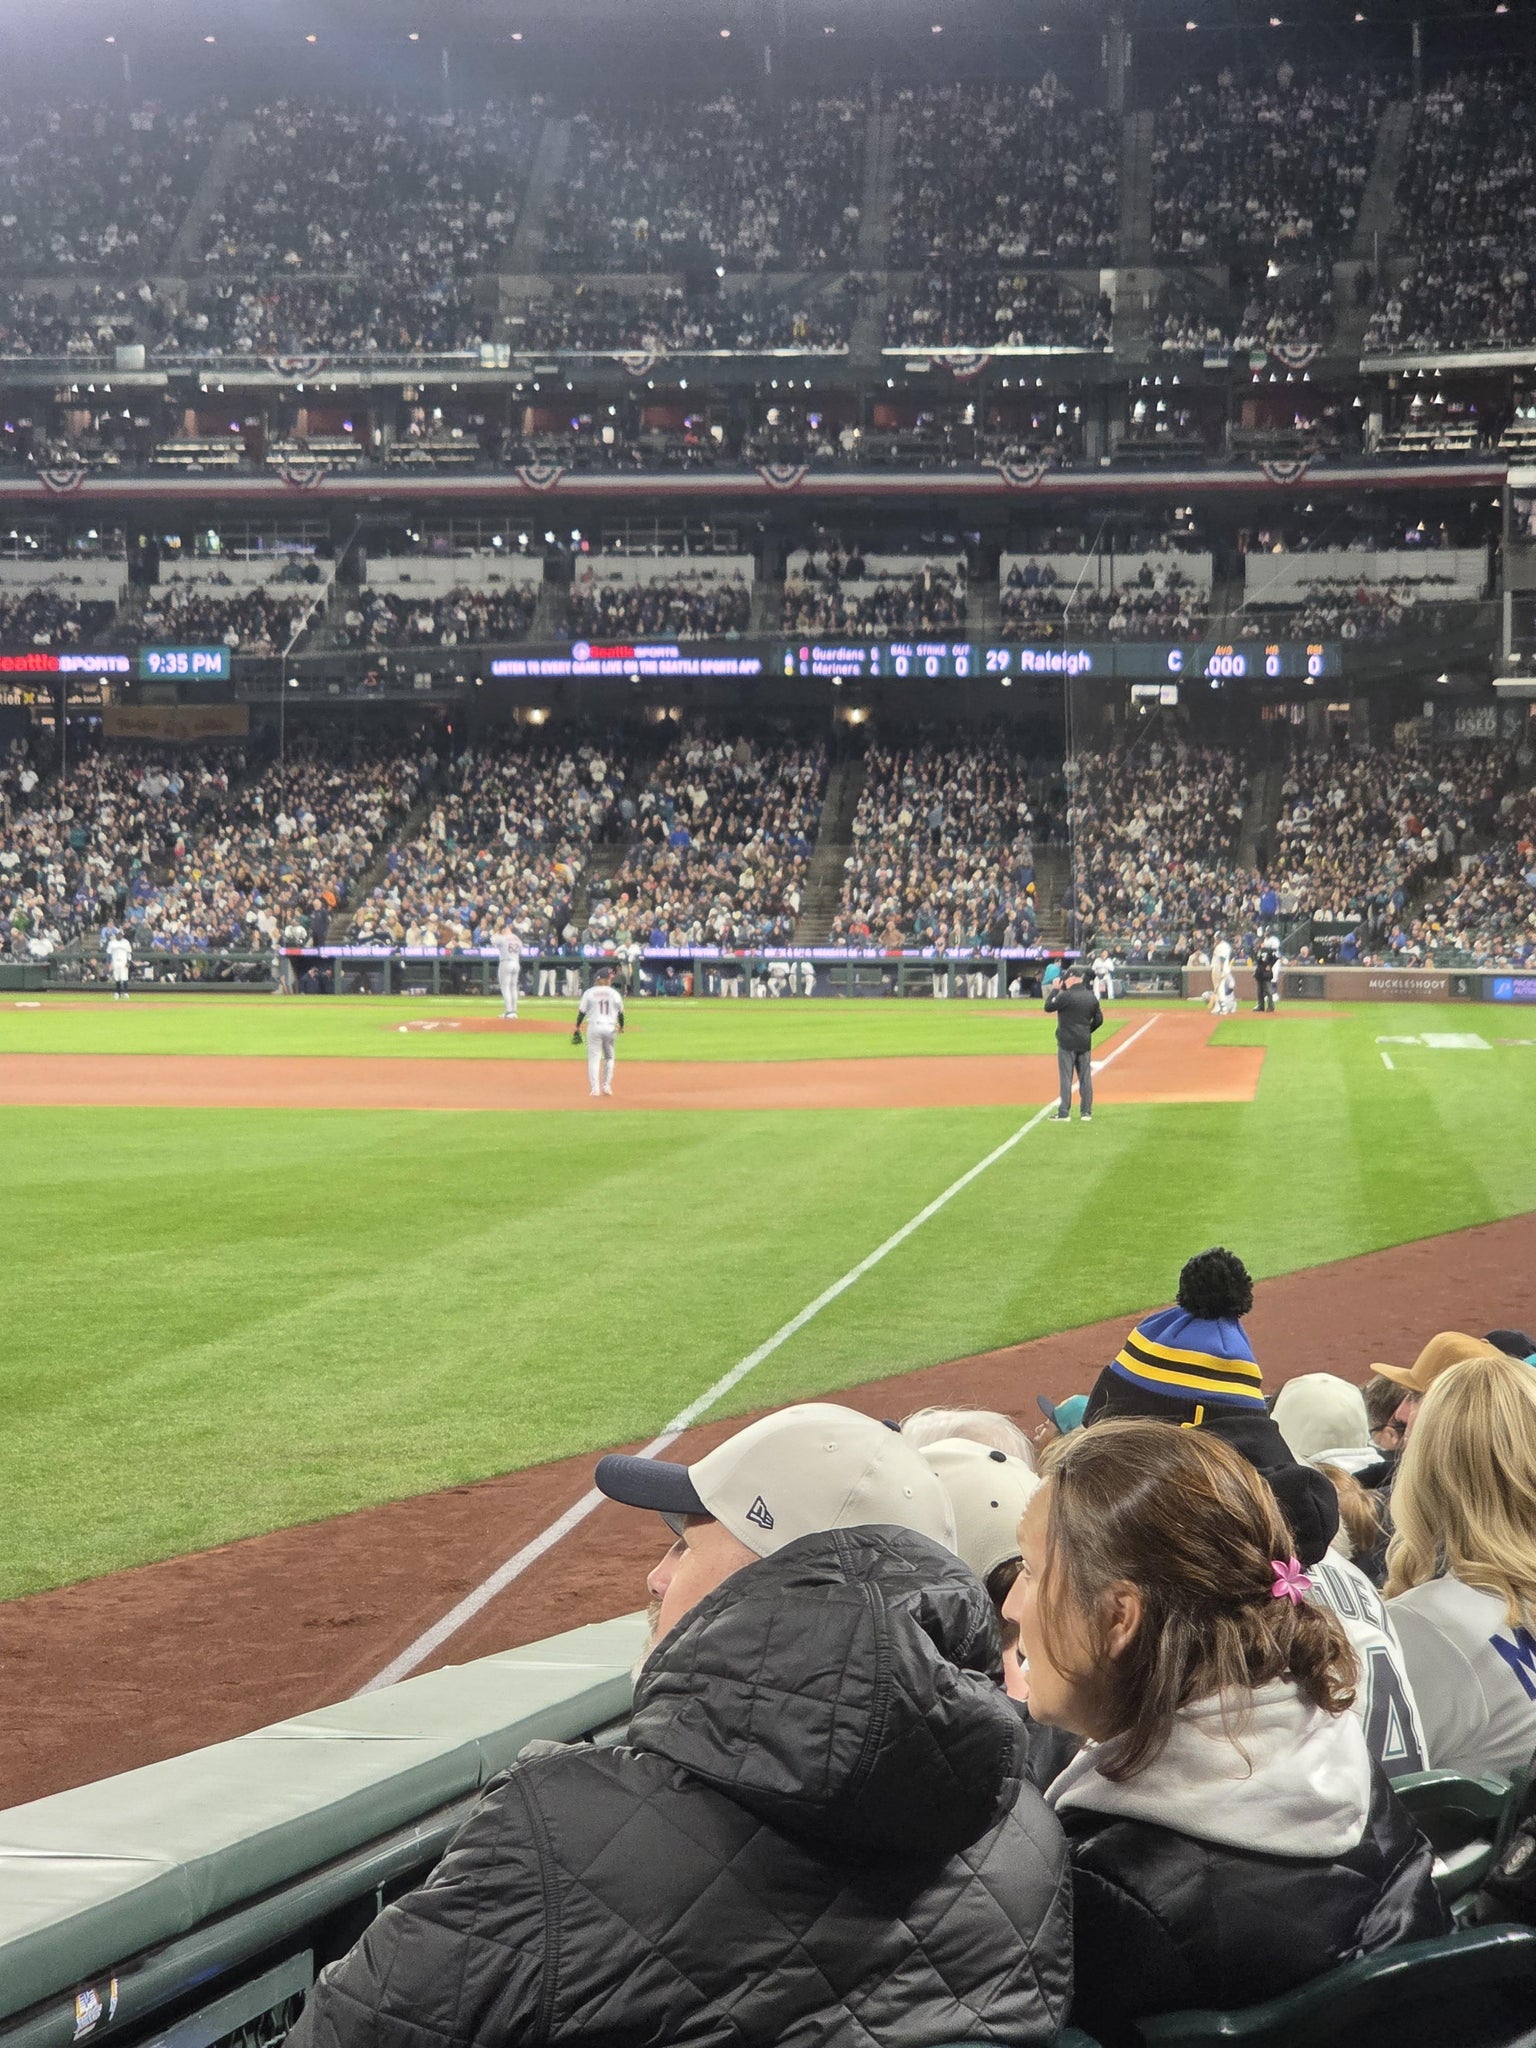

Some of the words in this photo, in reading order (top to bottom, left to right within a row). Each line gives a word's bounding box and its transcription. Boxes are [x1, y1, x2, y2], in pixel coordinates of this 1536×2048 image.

[812, 646, 865, 661] Guardians
[890, 644, 913, 656] BALL
[916, 644, 946, 656] STRIKE
[952, 644, 970, 656] OUT
[0, 653, 59, 671] eattle
[148, 652, 188, 673] 9:35
[192, 652, 221, 673] PM
[812, 661, 861, 676] Mariners
[895, 656, 908, 677] 0
[925, 656, 938, 677] 0
[955, 656, 968, 677] 0
[986, 649, 1010, 671] 29
[1021, 649, 1092, 675] Raleigh
[1167, 649, 1182, 672] C
[1204, 655, 1246, 677] .000
[1266, 655, 1280, 677] 0
[1308, 655, 1323, 677] 0
[1455, 719, 1497, 732] USED
[1368, 978, 1449, 989] MUCKLESHOOT
[599, 999, 609, 1015] 11
